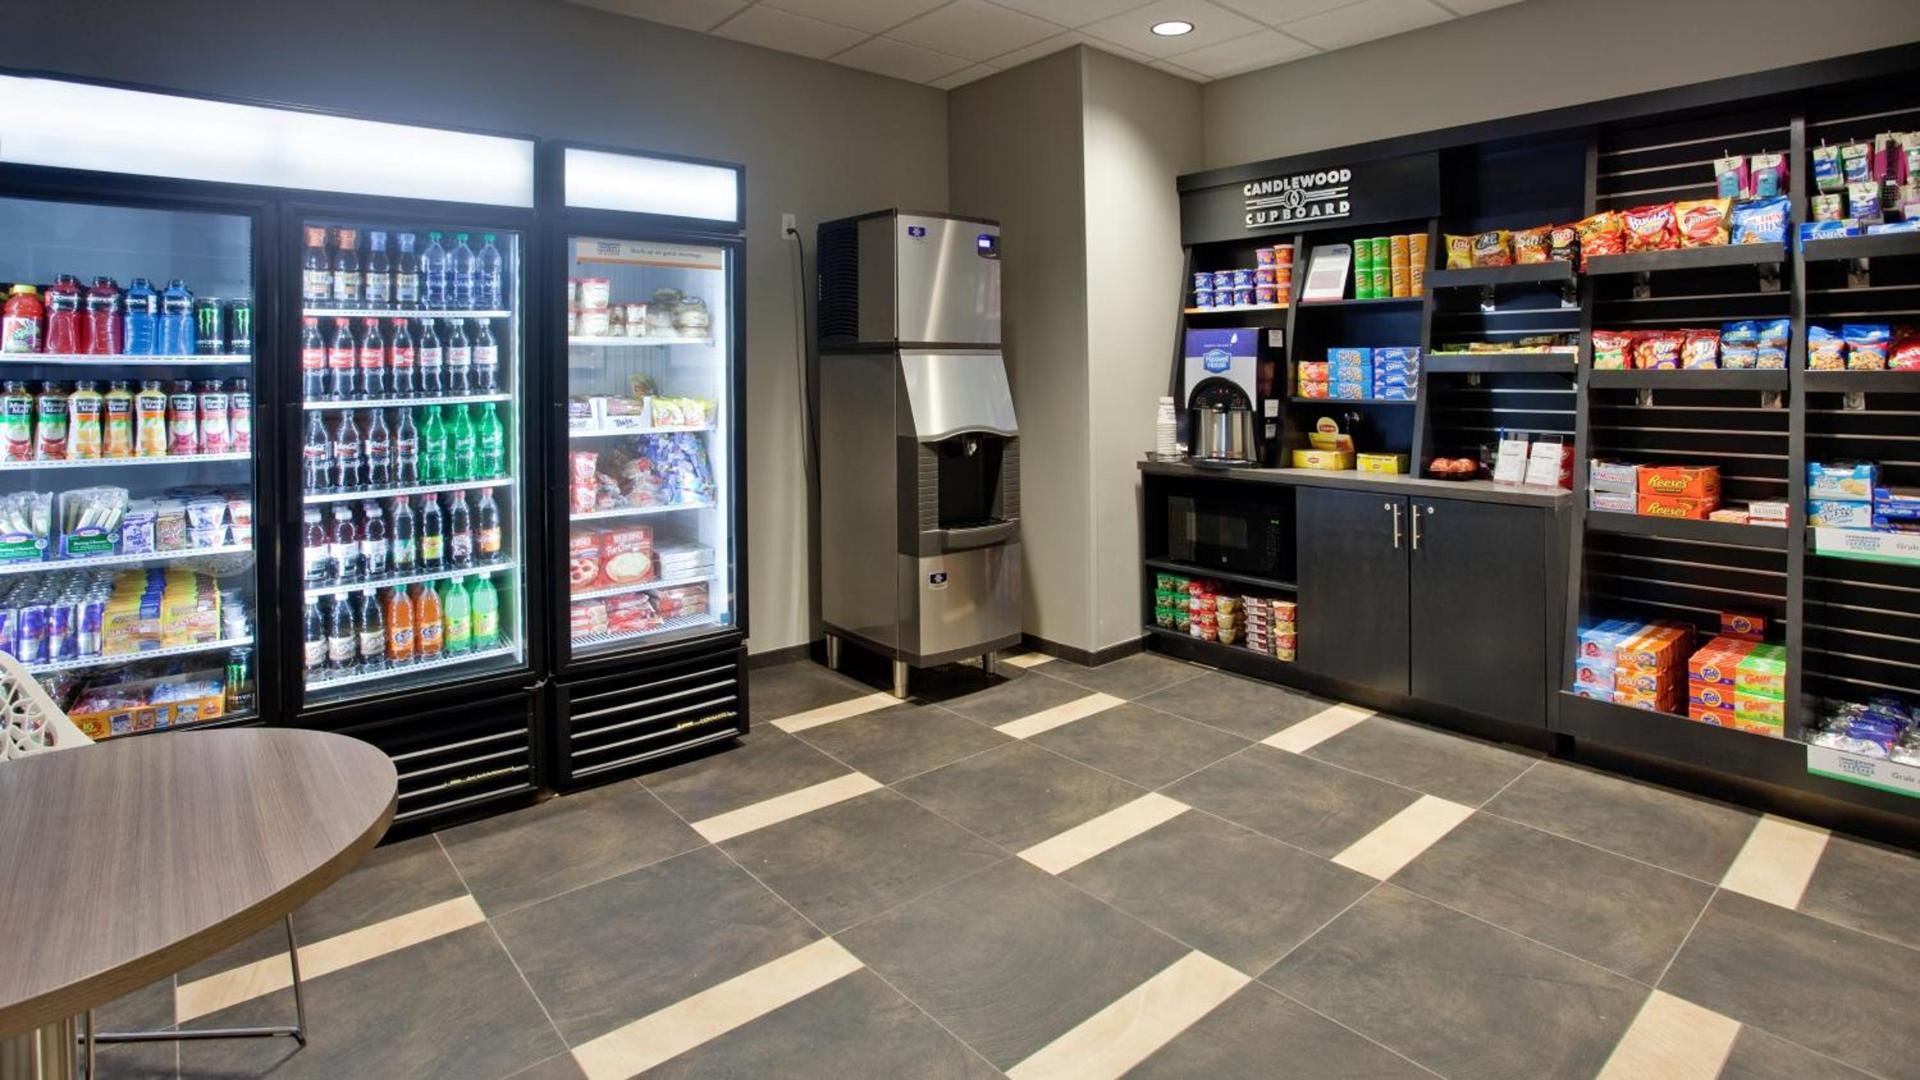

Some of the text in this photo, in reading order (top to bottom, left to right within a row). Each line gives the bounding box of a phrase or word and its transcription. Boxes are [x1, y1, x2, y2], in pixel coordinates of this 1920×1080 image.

[1243, 168, 1351, 196] CANDLEWOOD
[1245, 201, 1351, 225] CUPBOARD
[1648, 475, 1689, 489] Reese's
[1734, 620, 1750, 629] Tide
[1702, 668, 1719, 680] Tide
[1703, 692, 1719, 703] Tide
